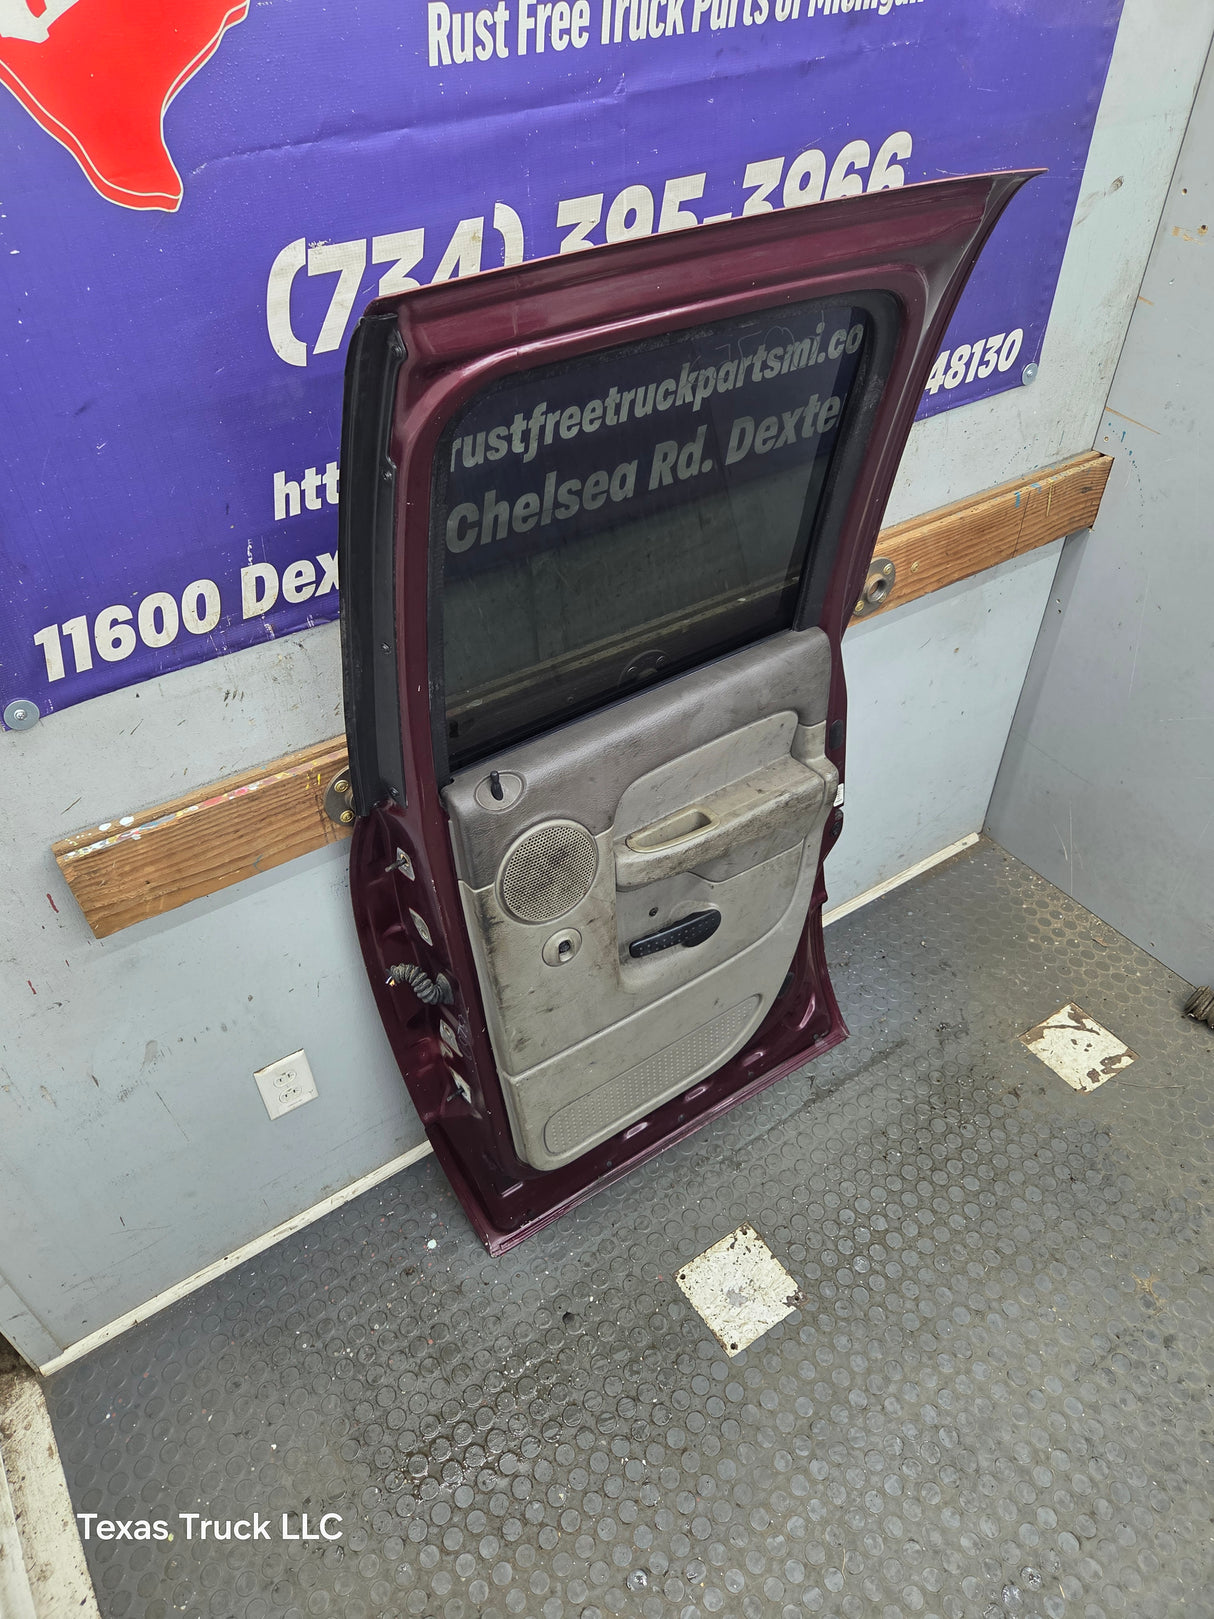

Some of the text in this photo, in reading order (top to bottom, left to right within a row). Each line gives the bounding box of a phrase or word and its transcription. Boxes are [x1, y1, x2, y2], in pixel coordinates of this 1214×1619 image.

[428, 1, 510, 67] Rust
[517, 0, 591, 56] Free
[601, 0, 685, 45] Truck
[33, 578, 222, 683] 11600
[446, 459, 639, 554] Chelsea
[648, 424, 714, 491] Rd.
[725, 393, 846, 466] Dexte
[925, 328, 1024, 396] 48130
